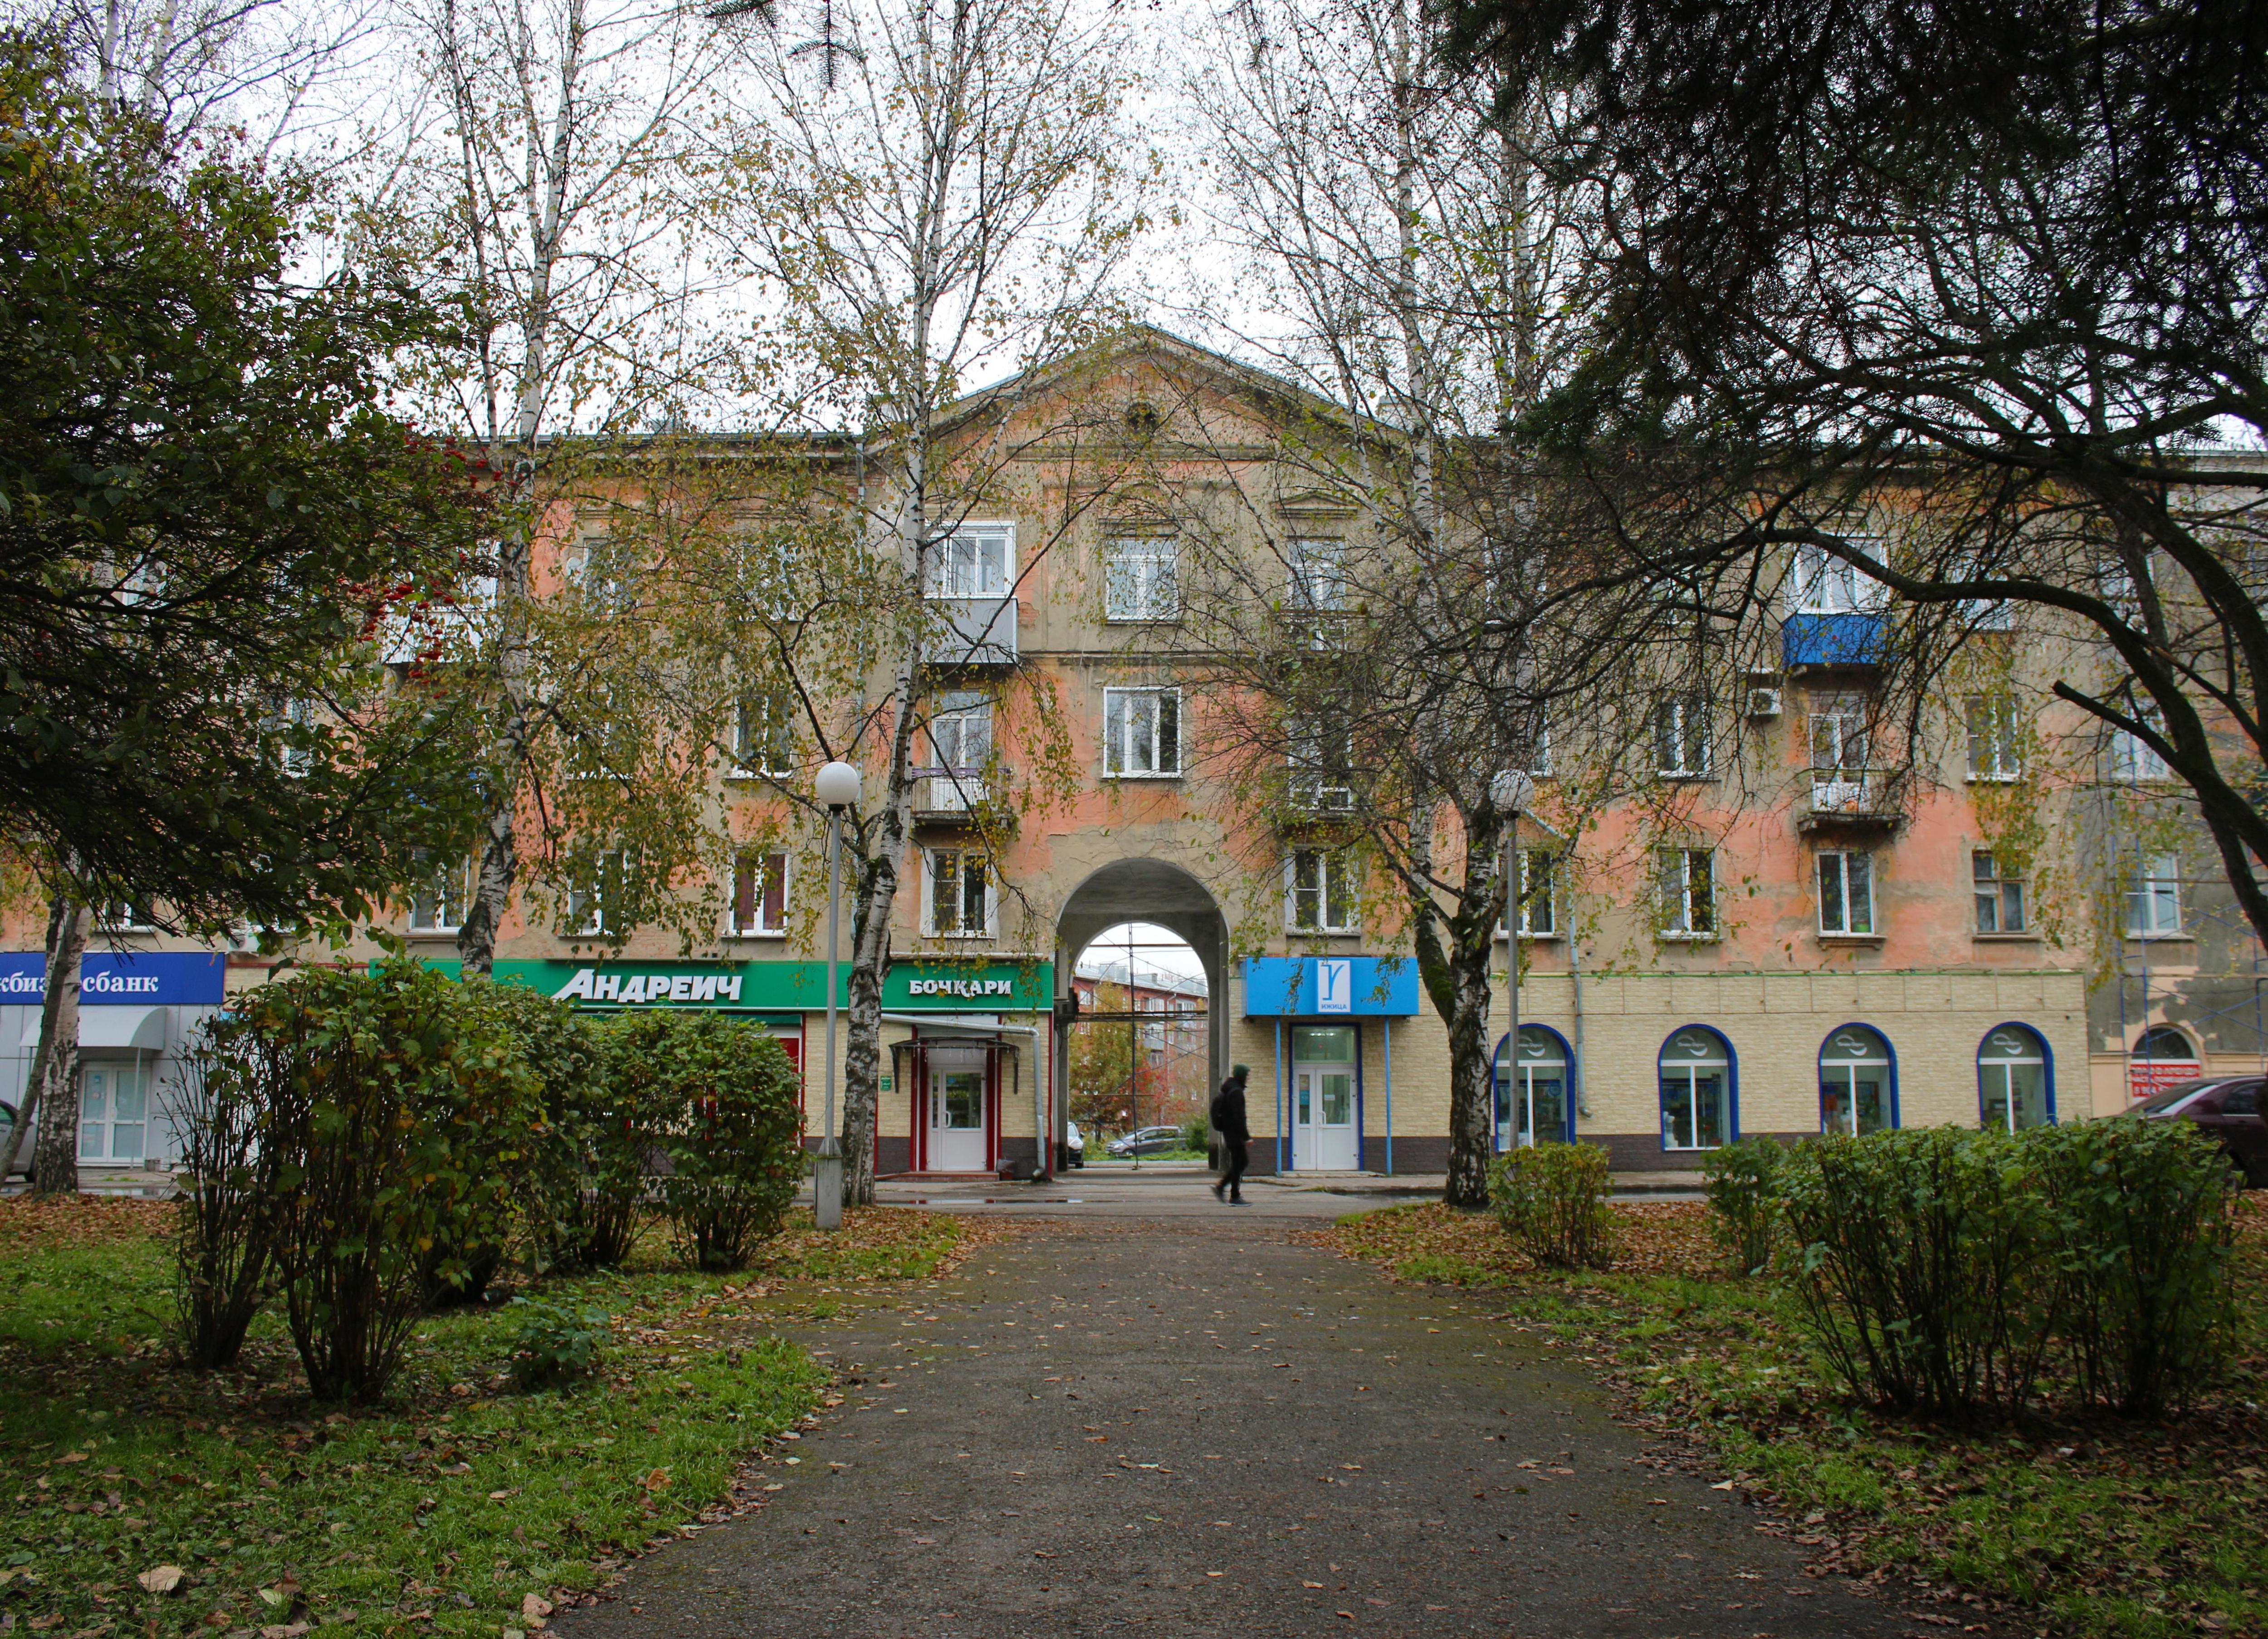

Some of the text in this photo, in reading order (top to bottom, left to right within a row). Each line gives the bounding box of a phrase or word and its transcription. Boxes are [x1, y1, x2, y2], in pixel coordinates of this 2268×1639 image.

[0, 970, 159, 993] кбизсбанк
[551, 969, 743, 1003] АНДРЕИЧ
[909, 979, 1012, 998] БОЧКАРИ
